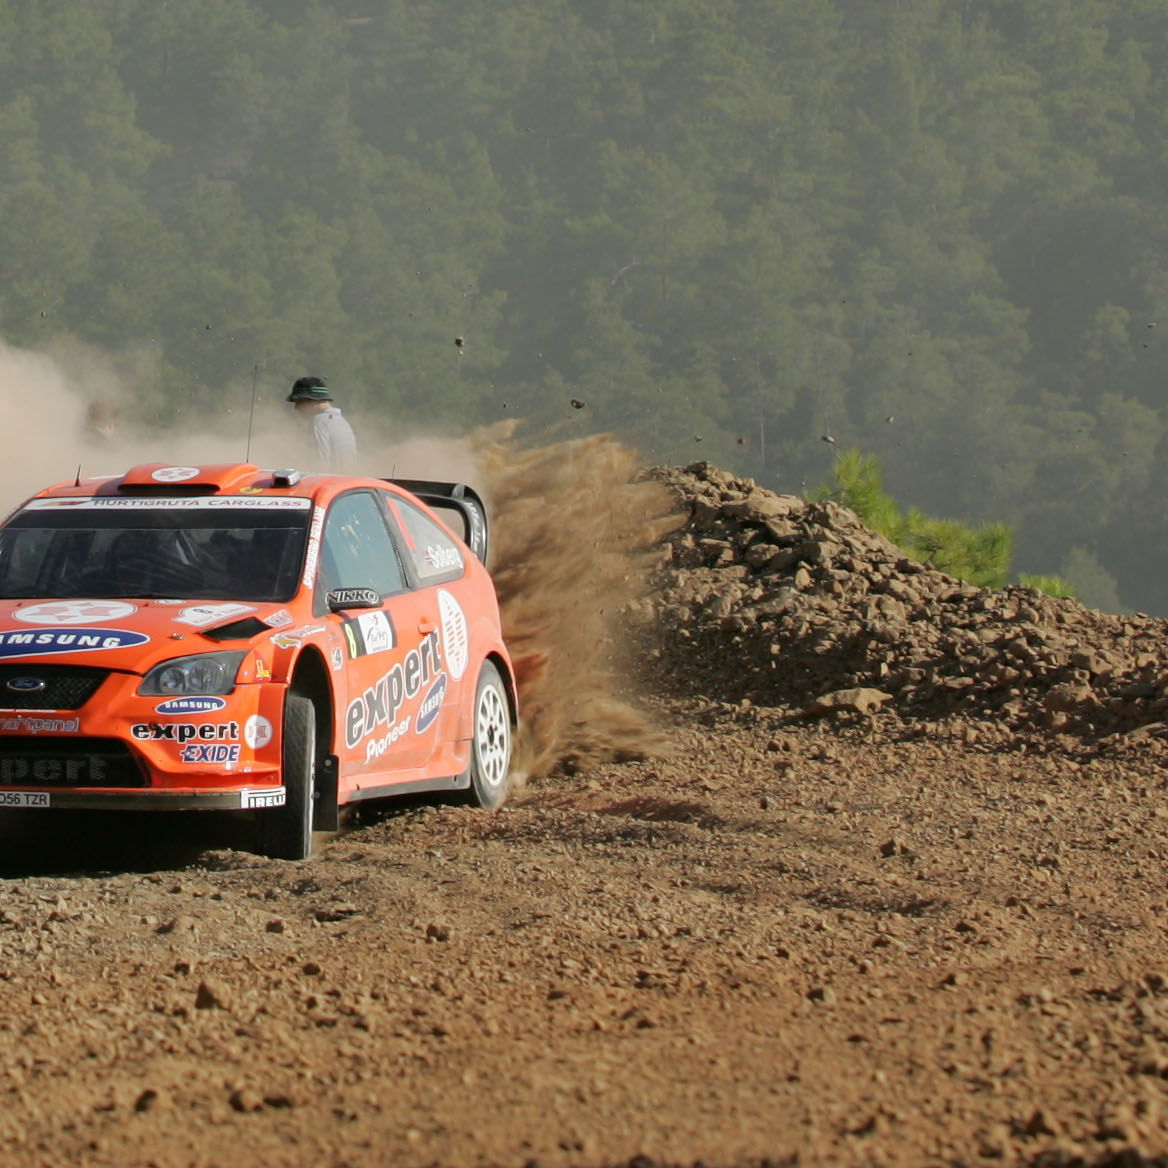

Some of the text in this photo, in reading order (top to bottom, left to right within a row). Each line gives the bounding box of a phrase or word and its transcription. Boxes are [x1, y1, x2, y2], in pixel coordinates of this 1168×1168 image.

[208, 499, 302, 507] CARGLASS
[326, 590, 379, 604] NIKKO
[345, 627, 442, 750] expert
[165, 701, 218, 710] SAMSUNG
[131, 721, 239, 743] expert
[364, 715, 411, 765] Pioneer
[181, 744, 240, 763] EXIDE
[24, 794, 47, 805] TZR
